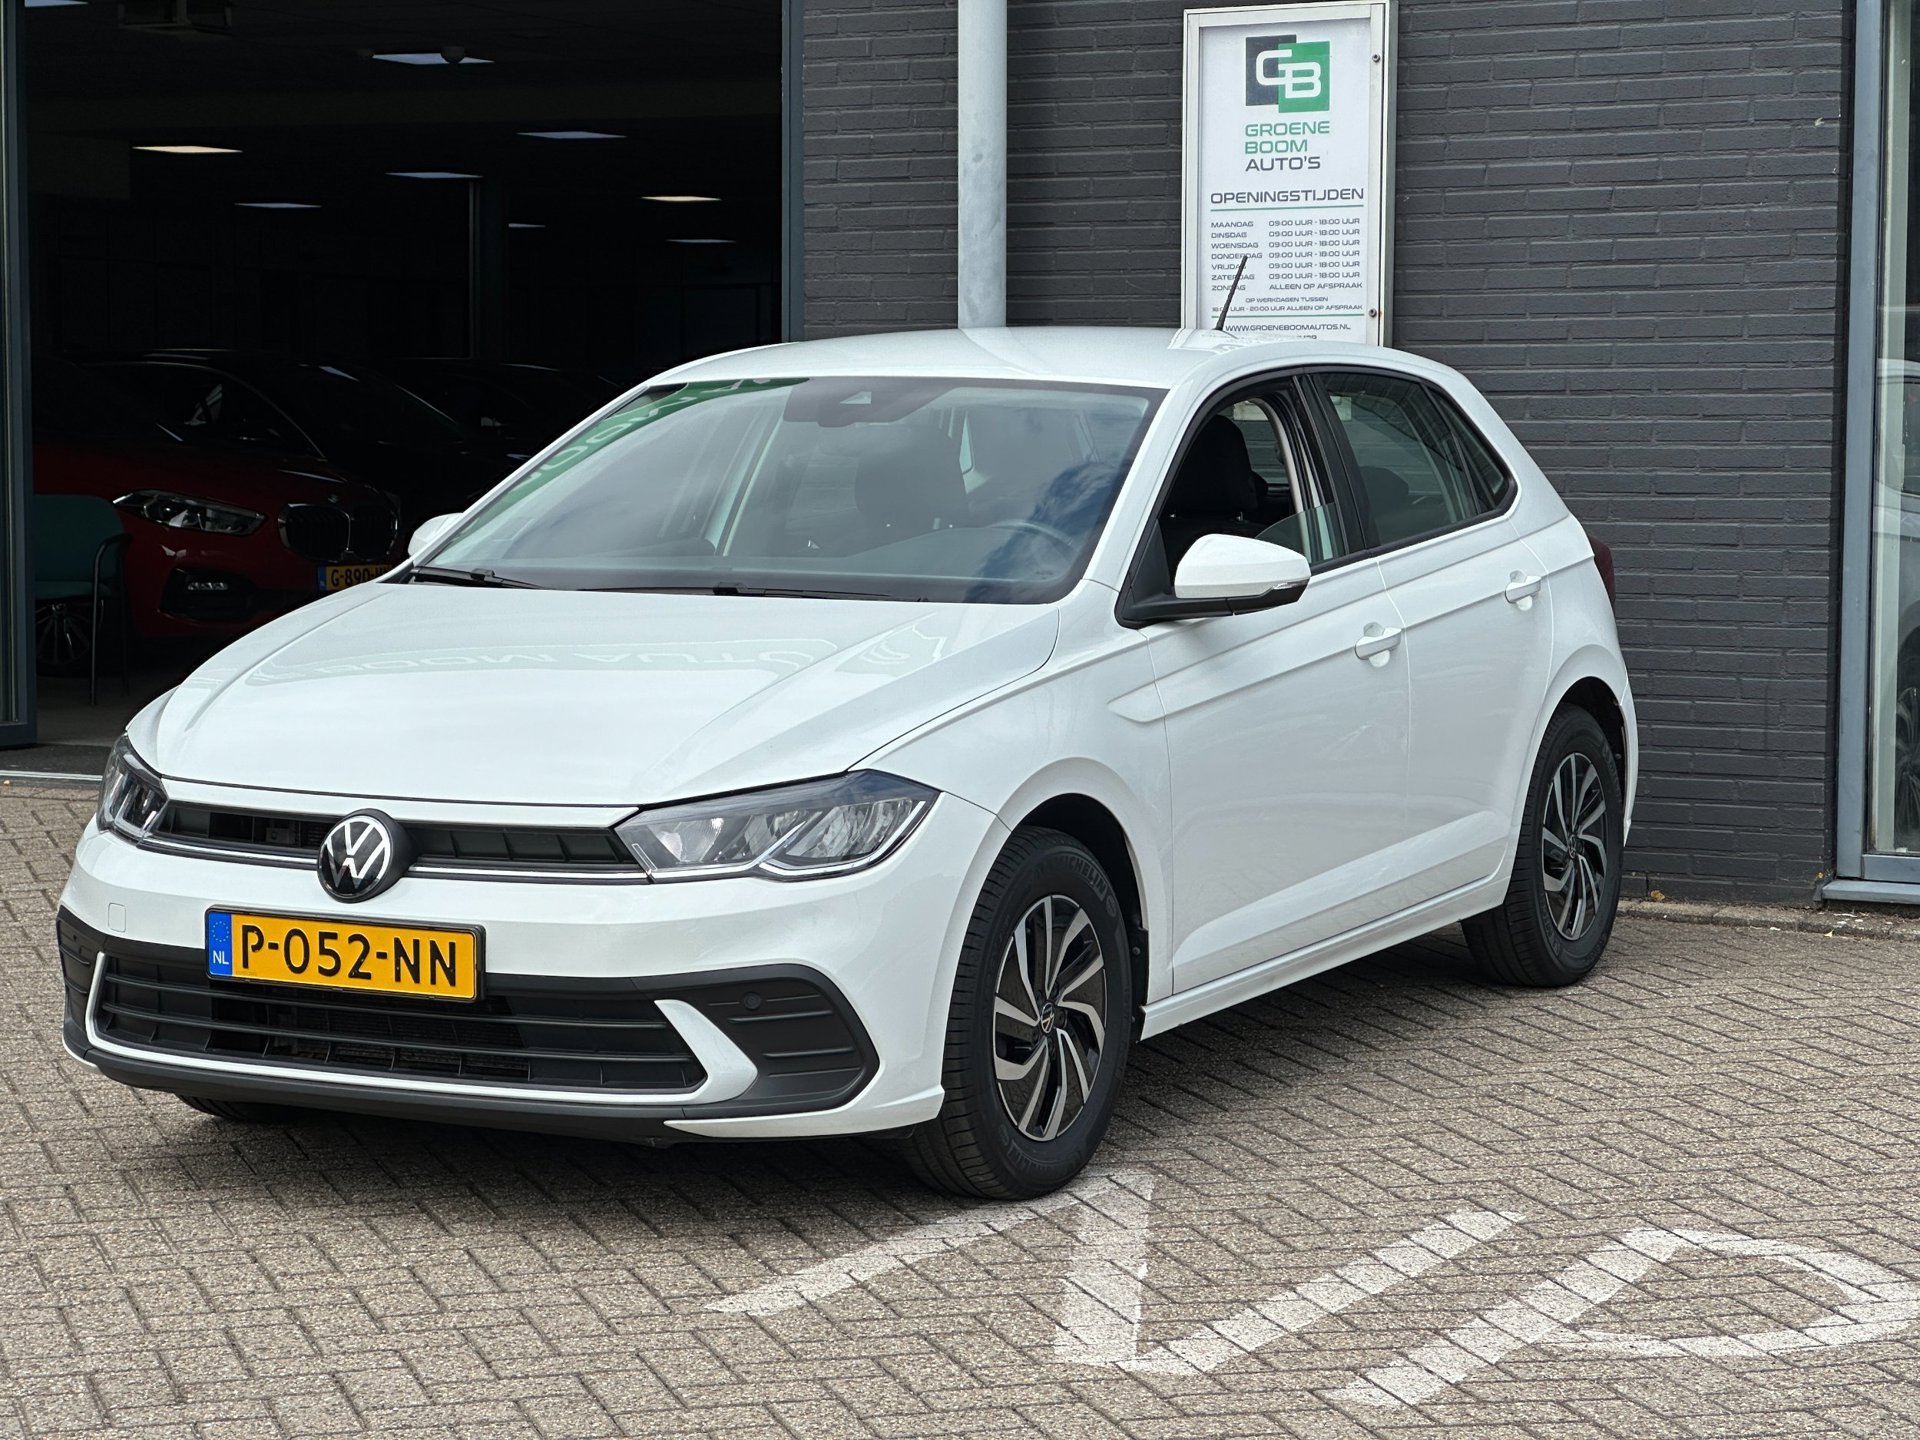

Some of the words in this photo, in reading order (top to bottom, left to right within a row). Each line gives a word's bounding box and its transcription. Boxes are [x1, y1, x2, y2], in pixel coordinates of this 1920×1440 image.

[1245, 120, 1330, 137] GROENE
[1245, 139, 1308, 155] BOOM
[1245, 156, 1321, 172] AUTO'S
[1210, 188, 1364, 204] OPENINGSTIJDEN
[1211, 231, 1247, 239] DINSDAG
[212, 950, 230, 966] NL
[241, 924, 457, 987] P-052-NN
